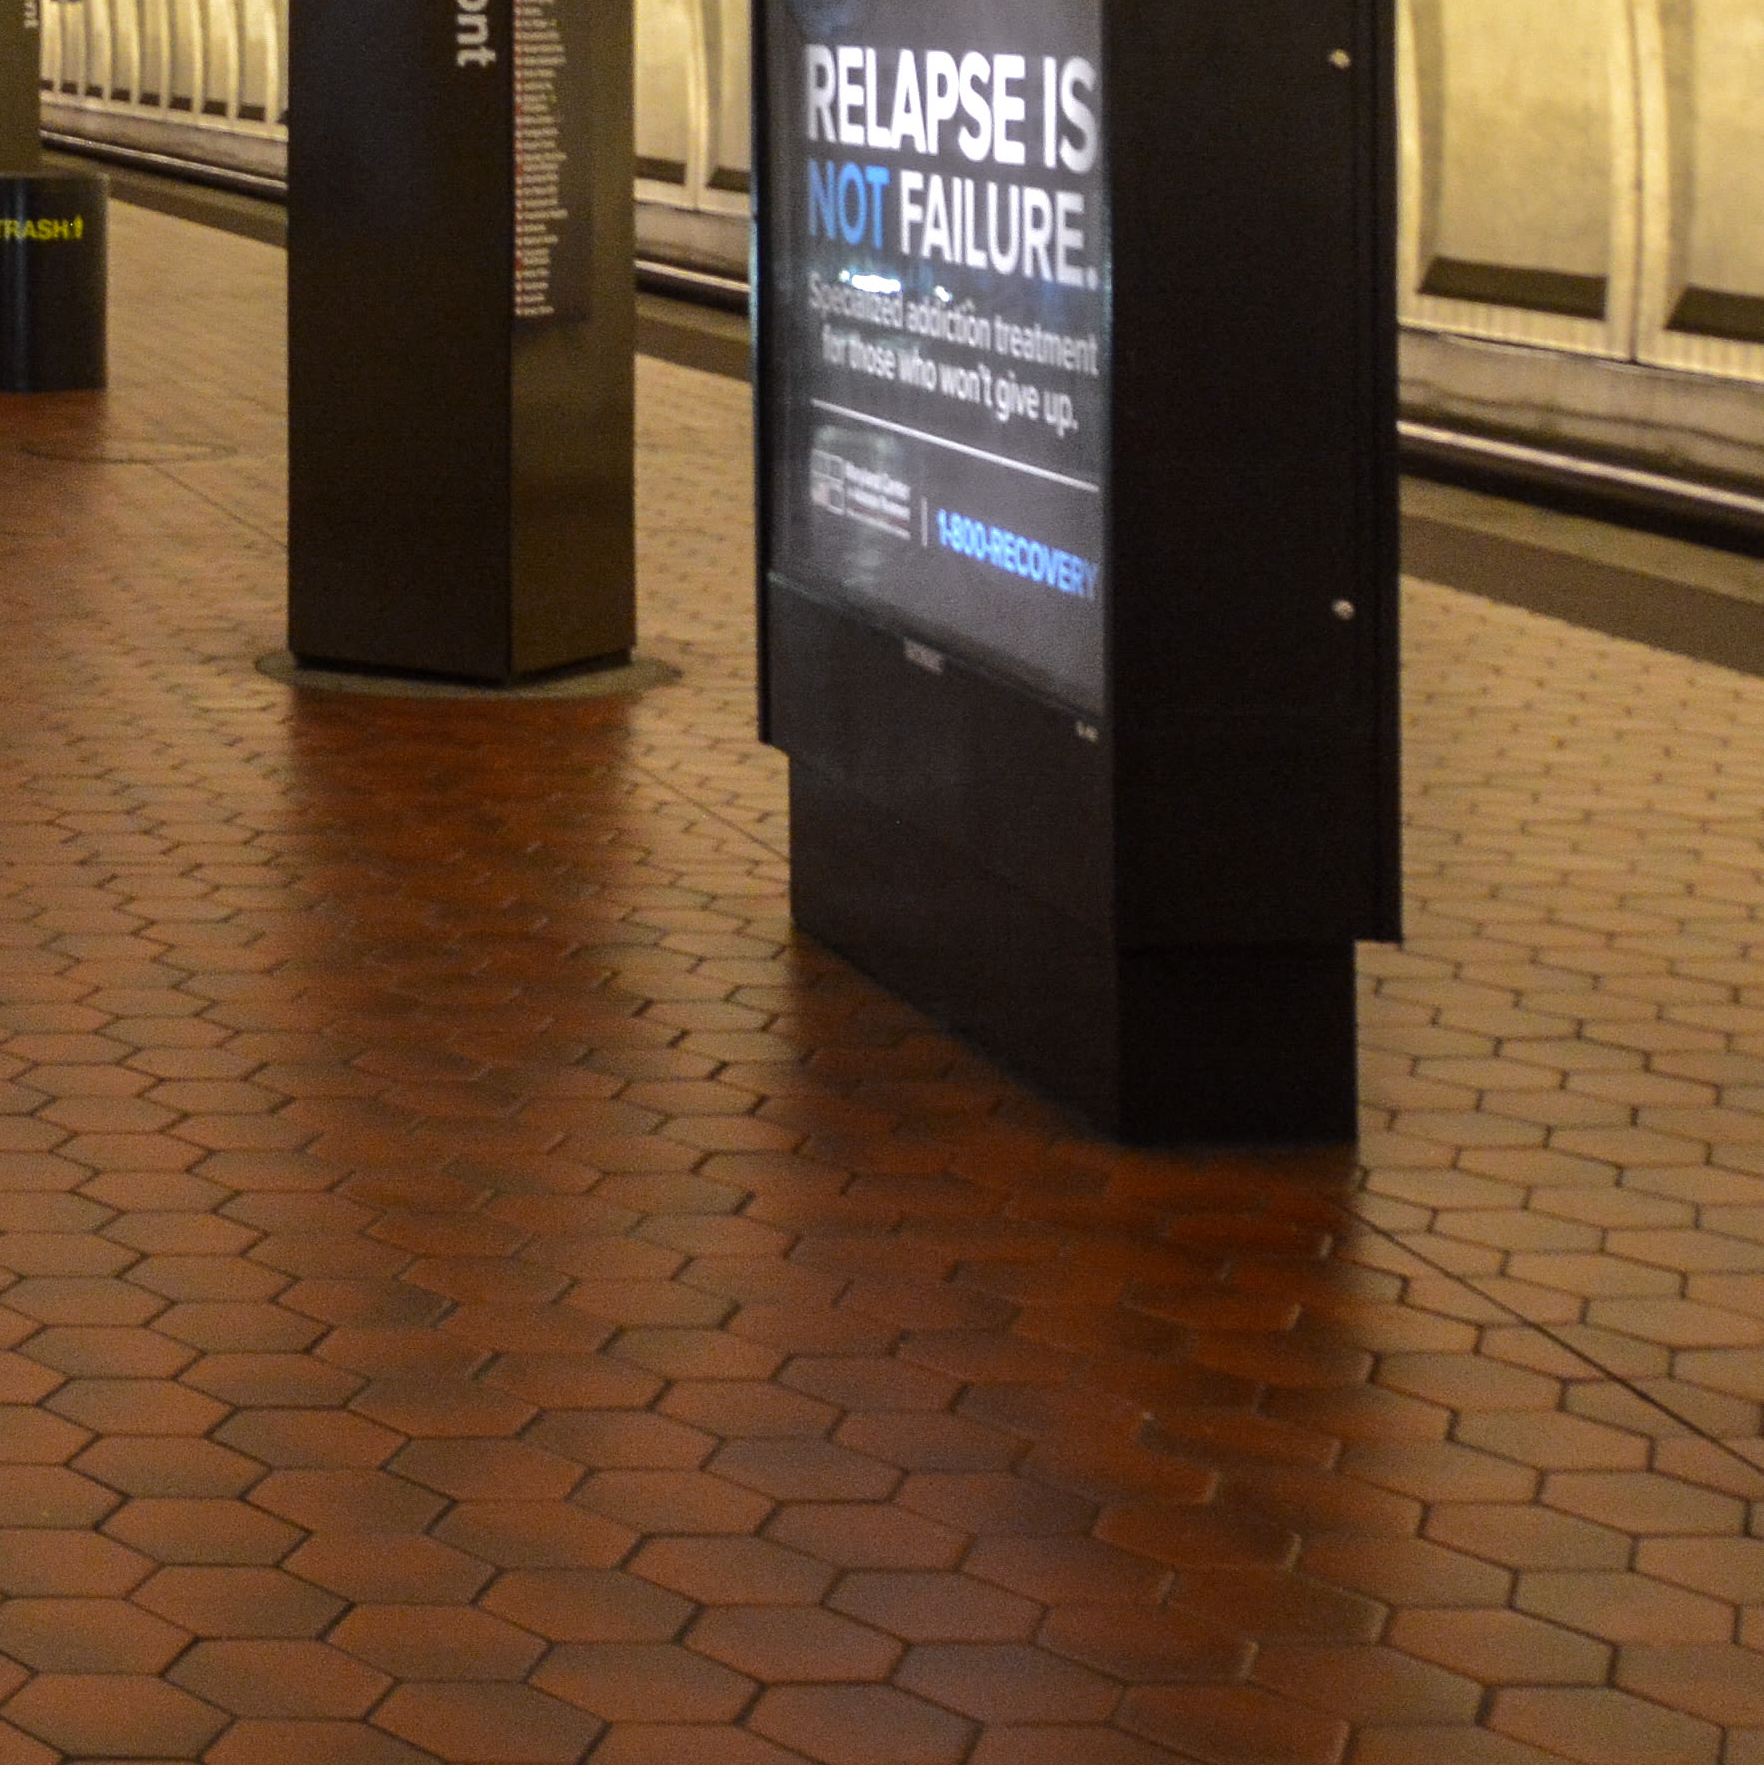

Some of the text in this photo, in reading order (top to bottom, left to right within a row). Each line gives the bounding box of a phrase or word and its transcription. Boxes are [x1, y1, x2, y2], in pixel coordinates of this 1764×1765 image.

[806, 44, 1099, 173] RELAPSE IS
[808, 158, 1099, 291] NOT FAILURE.
[808, 271, 1099, 377] Specialized addiction treatment
[822, 324, 1079, 438] for those who won't give up.
[936, 508, 1098, 602] 1-800-RECOVERY
